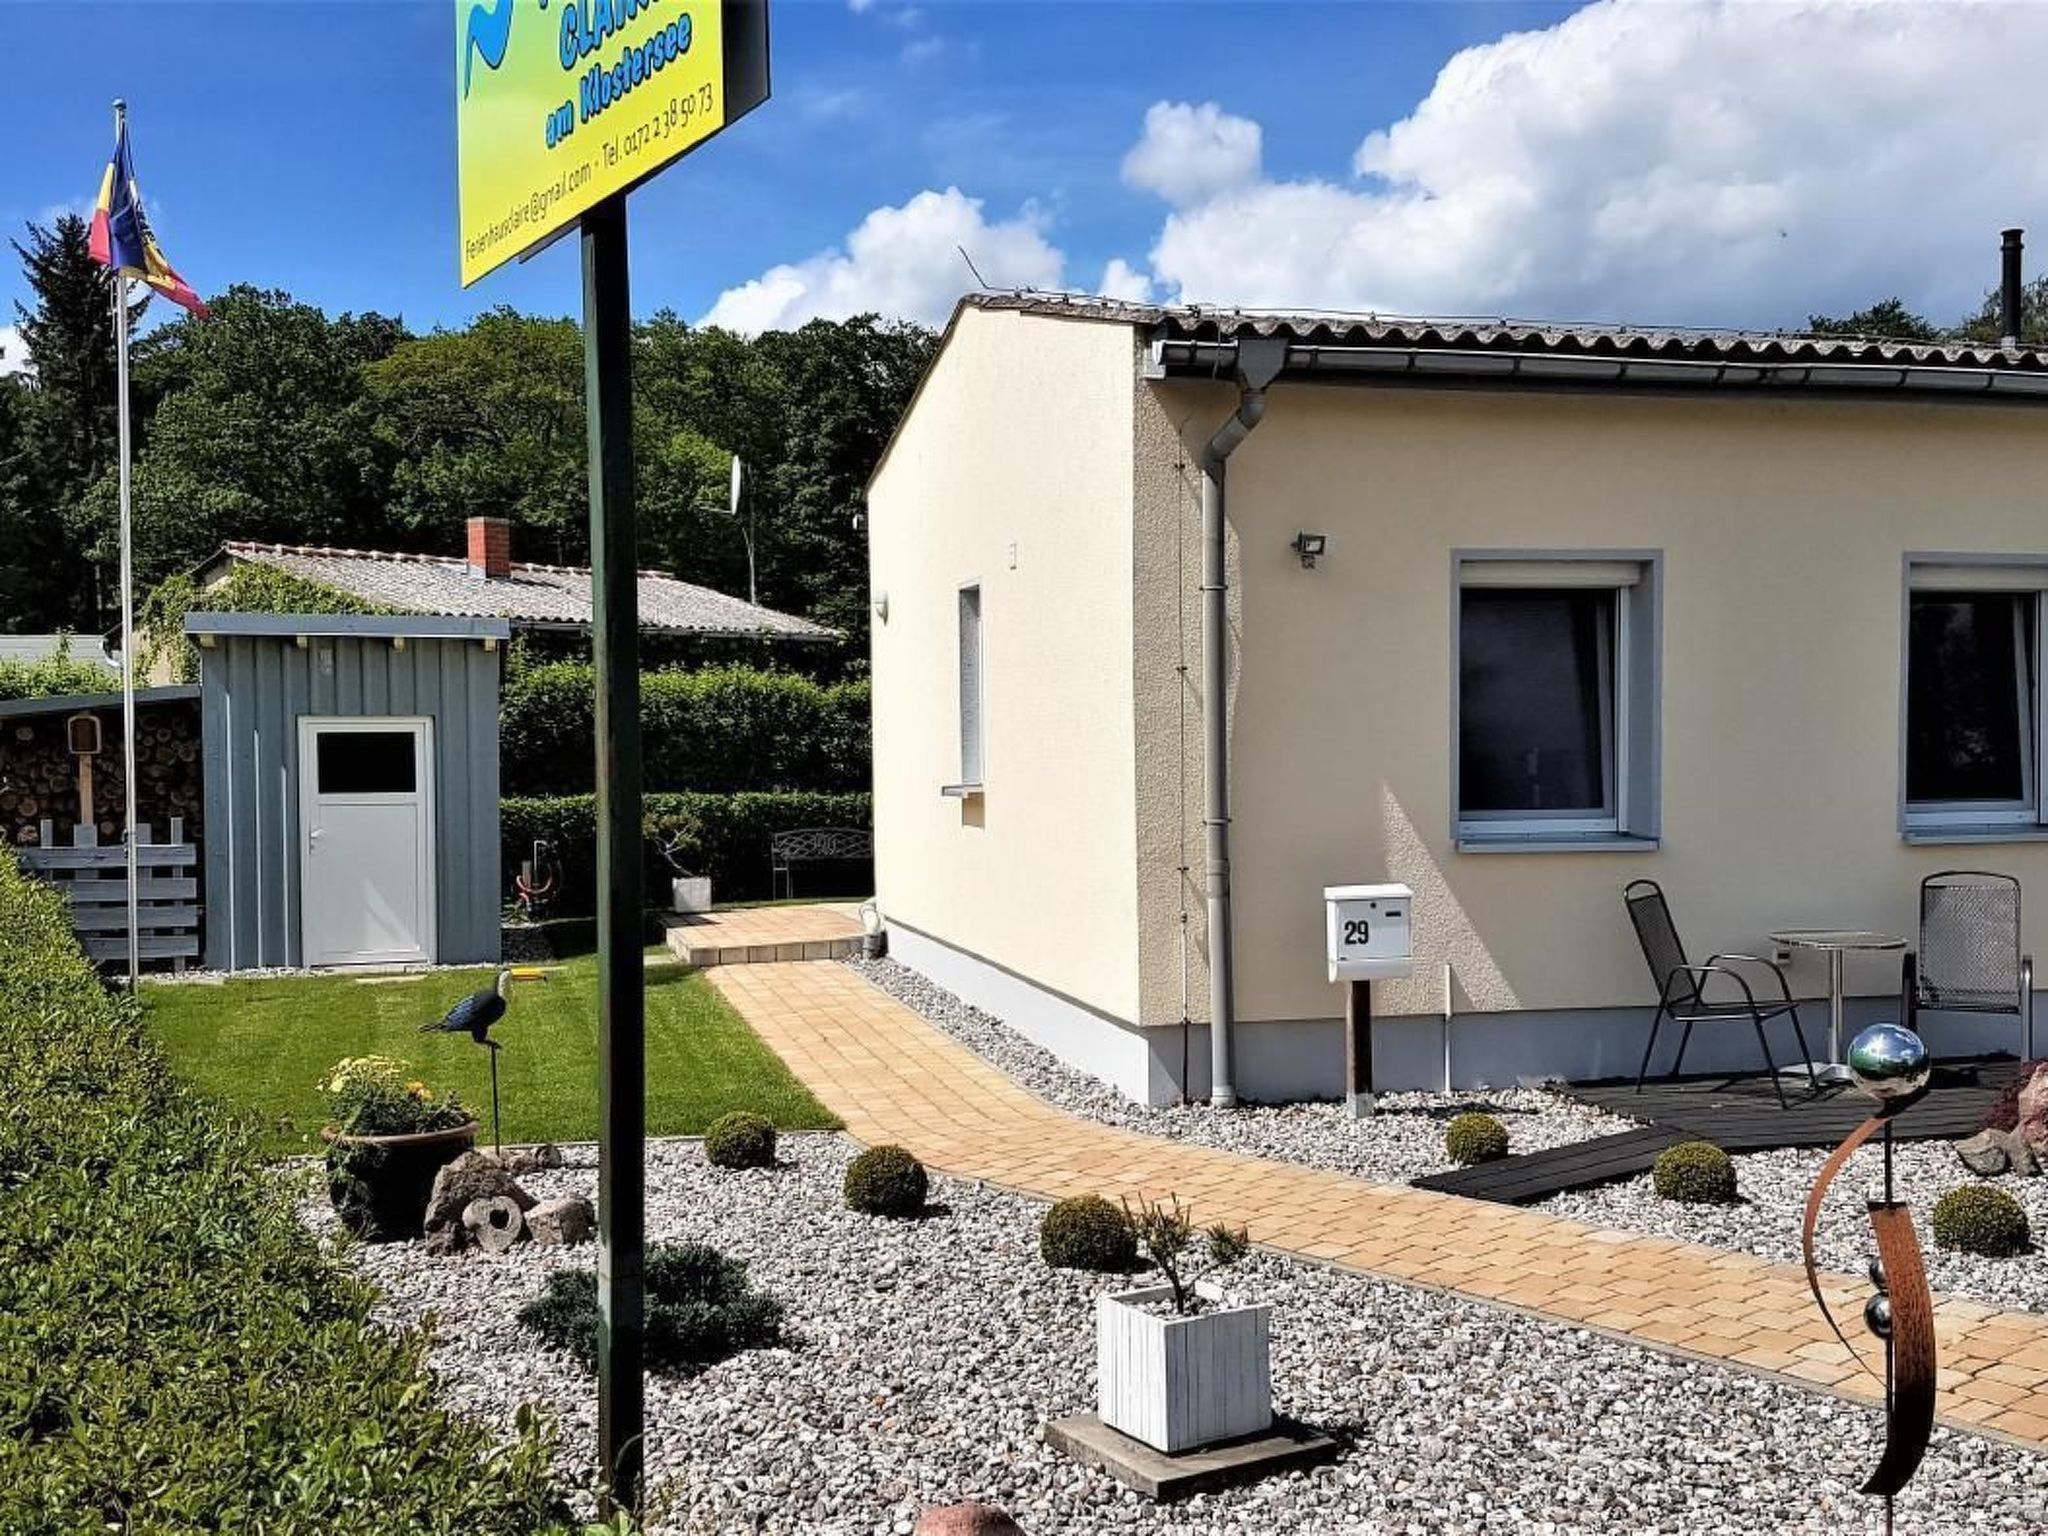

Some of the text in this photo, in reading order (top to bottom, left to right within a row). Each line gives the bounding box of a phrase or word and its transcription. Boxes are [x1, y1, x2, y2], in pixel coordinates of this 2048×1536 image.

[546, 12, 692, 148] am Klostersee
[602, 134, 622, 169] Tel.
[624, 123, 650, 156] 0172
[653, 115, 661, 138] 2
[663, 98, 677, 139] 38
[681, 94, 696, 128] 50
[699, 82, 713, 117] 73
[1344, 920, 1369, 945] 29
